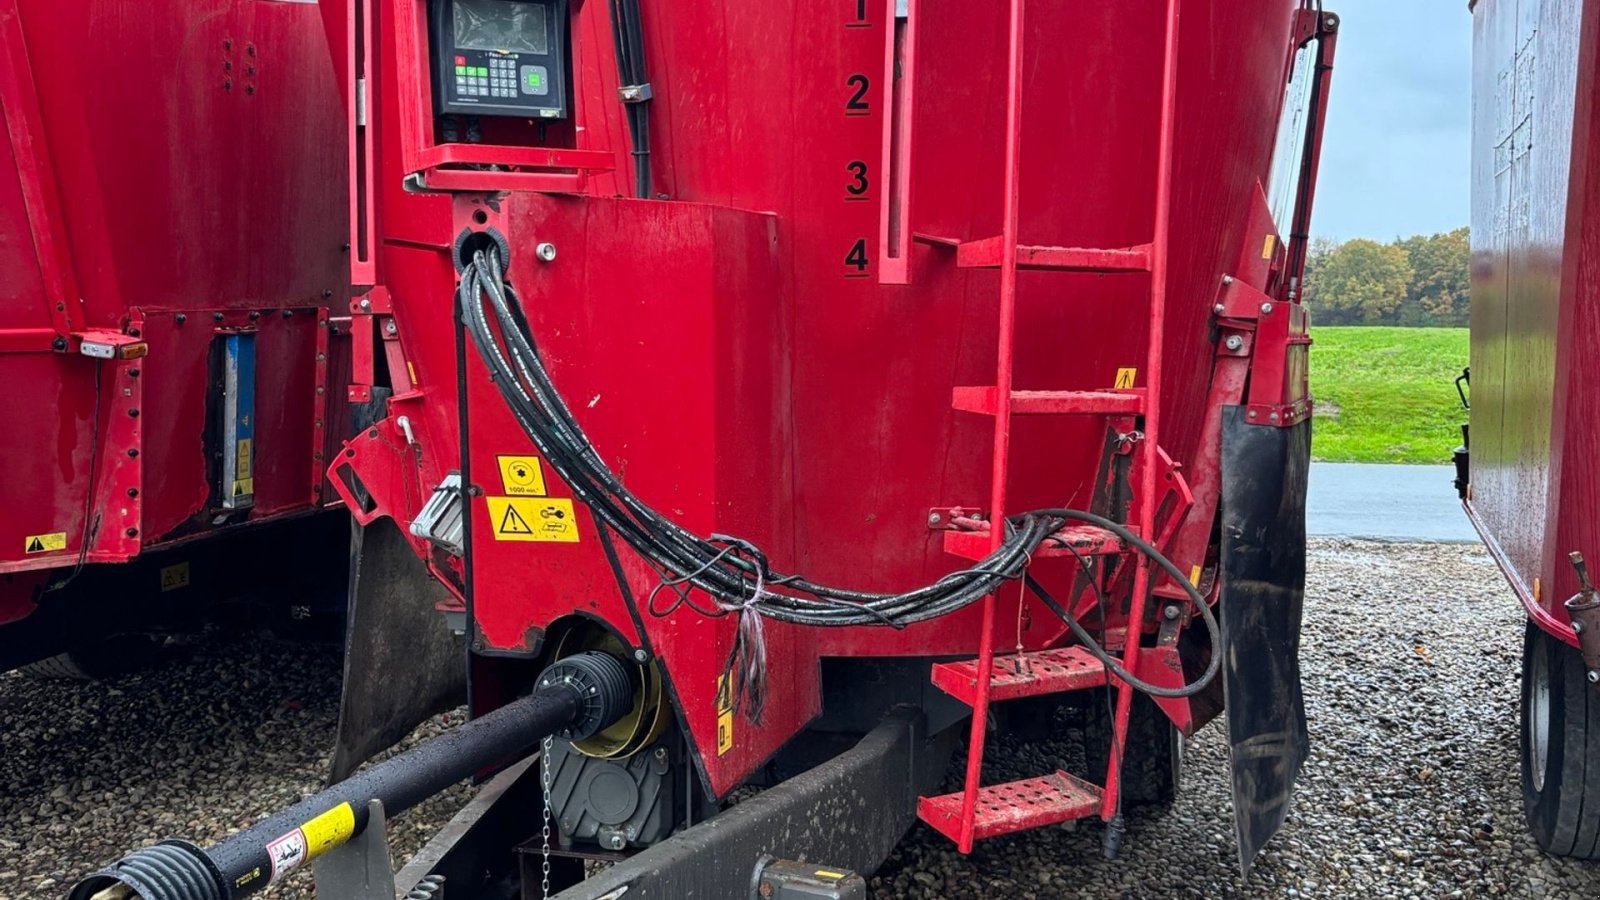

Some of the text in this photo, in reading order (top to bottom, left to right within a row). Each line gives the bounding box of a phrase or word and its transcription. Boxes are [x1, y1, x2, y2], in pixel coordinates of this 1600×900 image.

[847, 75, 869, 109] 2
[847, 161, 869, 194] 3
[845, 239, 869, 271] 4
